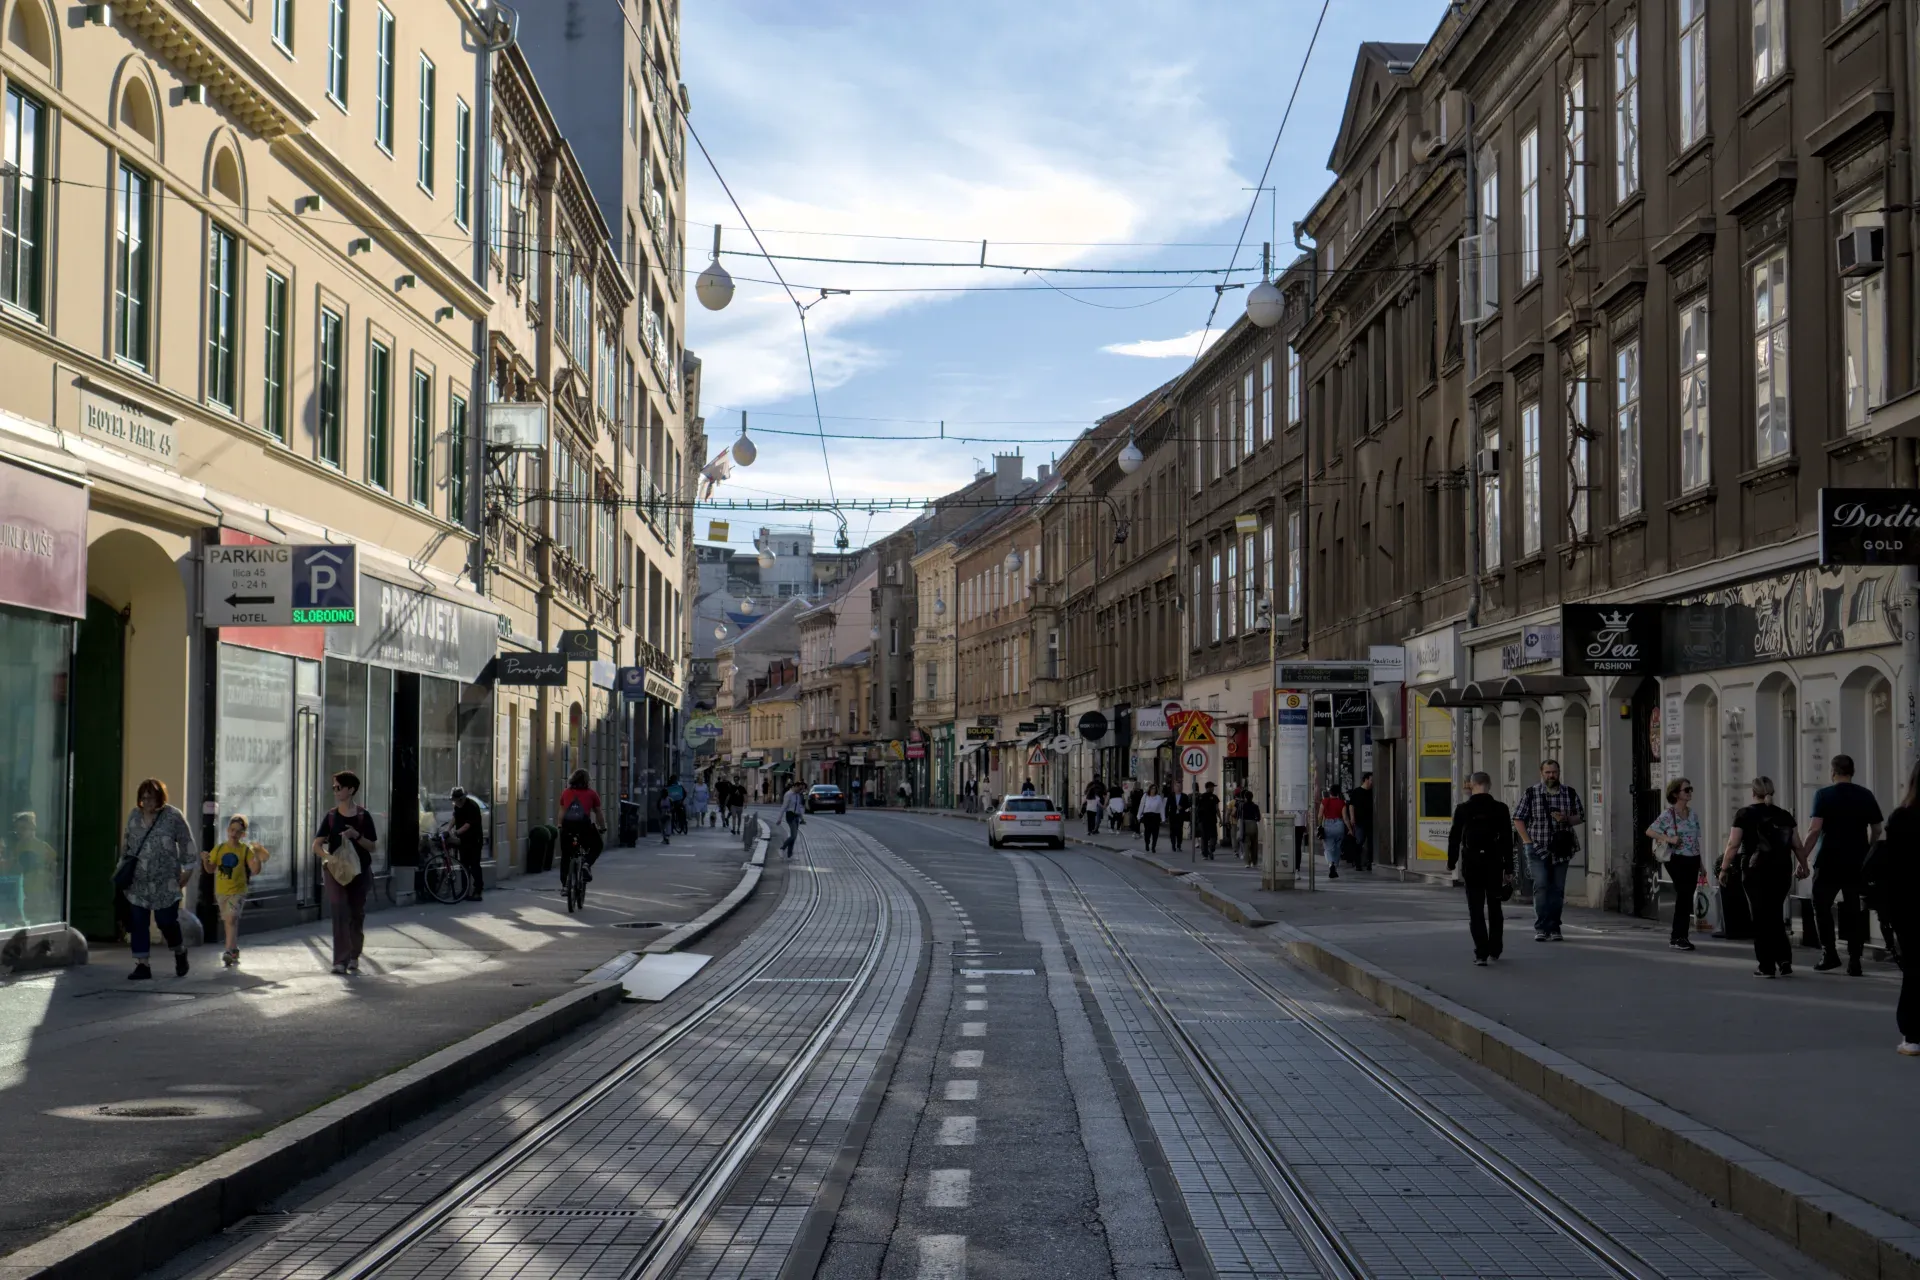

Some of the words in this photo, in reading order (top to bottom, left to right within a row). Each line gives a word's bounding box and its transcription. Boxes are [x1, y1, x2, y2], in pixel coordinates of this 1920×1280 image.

[87, 404, 125, 440] HOTEL
[129, 420, 156, 451] PARK
[159, 433, 171, 456] 45
[22, 528, 31, 552] &
[32, 528, 54, 558] VIŠE
[1863, 540, 1903, 550] GOLD
[210, 549, 288, 564] PARKING
[232, 568, 250, 577] Ilica
[253, 568, 265, 577] 45
[231, 580, 238, 589] 0
[246, 580, 258, 589] 24
[261, 580, 267, 589] h
[310, 565, 337, 604] P
[232, 613, 267, 623] HOTEL
[293, 609, 354, 623] SLOBODNO
[381, 586, 459, 645] PROSVJETA
[1586, 628, 1639, 657] Tea
[1594, 662, 1632, 670] FASHION
[1335, 697, 1366, 718] Lena
[1187, 754, 1203, 767] 40
